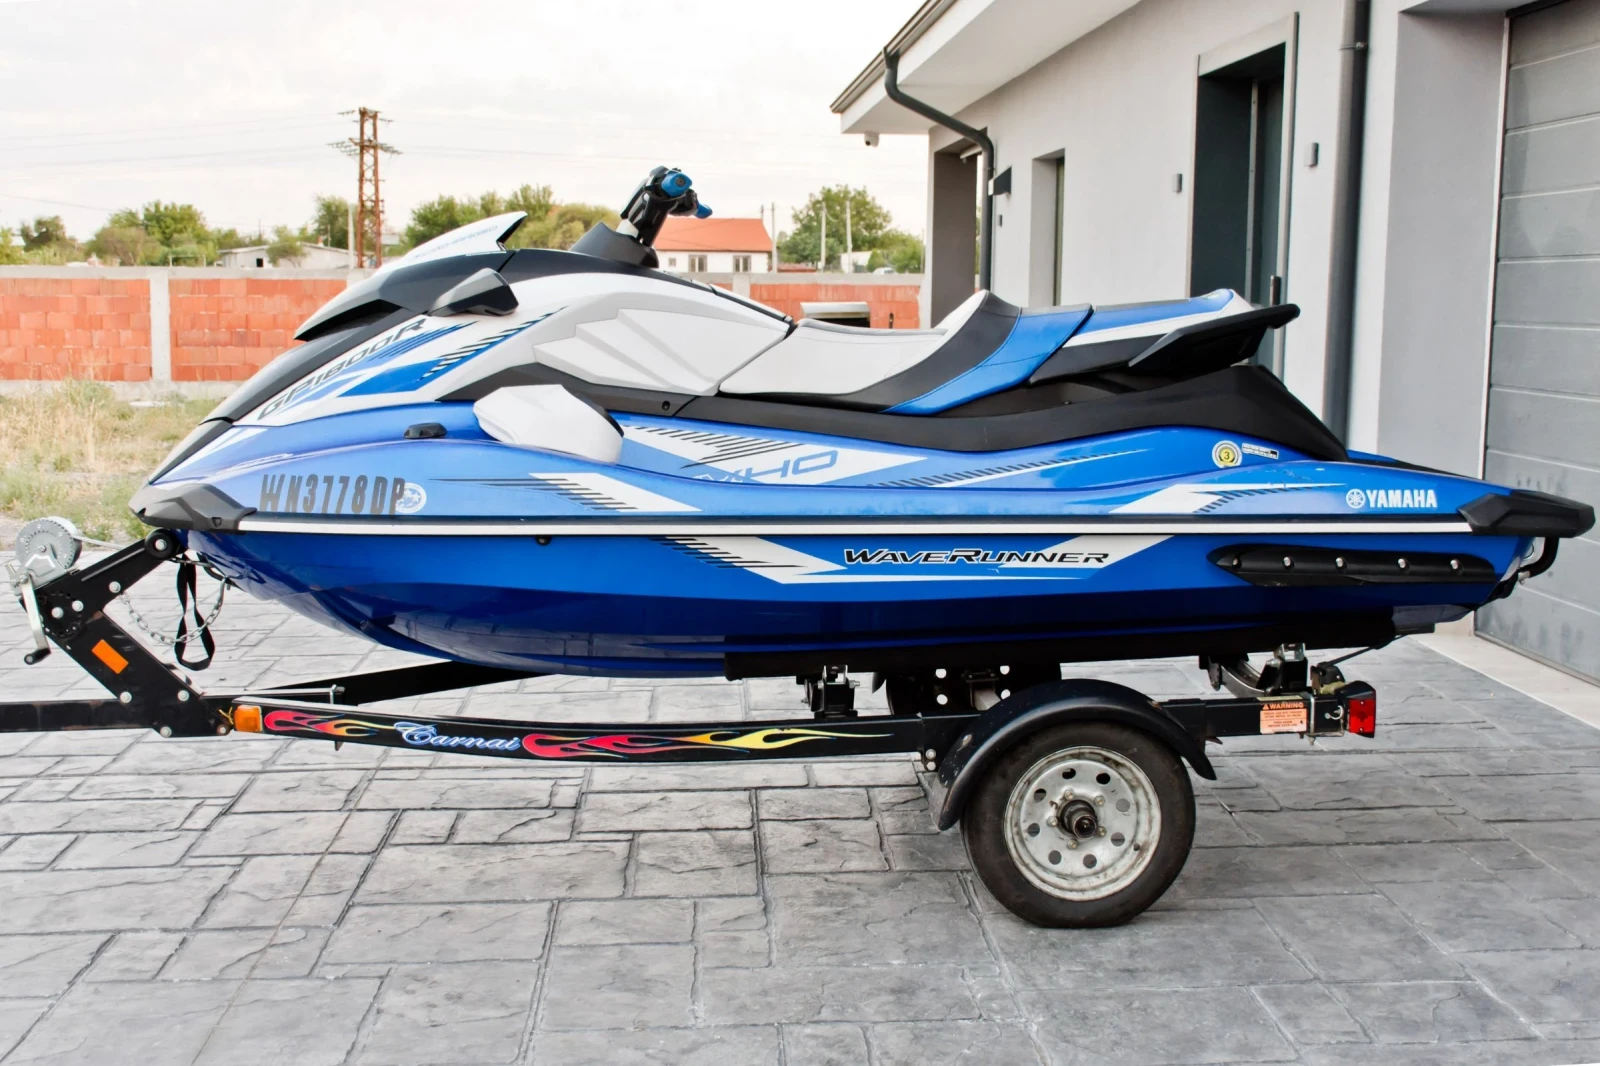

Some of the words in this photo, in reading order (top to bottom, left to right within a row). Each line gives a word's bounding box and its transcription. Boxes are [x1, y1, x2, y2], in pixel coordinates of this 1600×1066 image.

[257, 318, 426, 421] GP1800R
[1223, 451, 1231, 460] 3
[259, 474, 406, 516] WN3778DP
[1366, 489, 1438, 508] YAMAHA
[844, 548, 1109, 565] WAVERUNNER
[1269, 702, 1304, 710] WARNING
